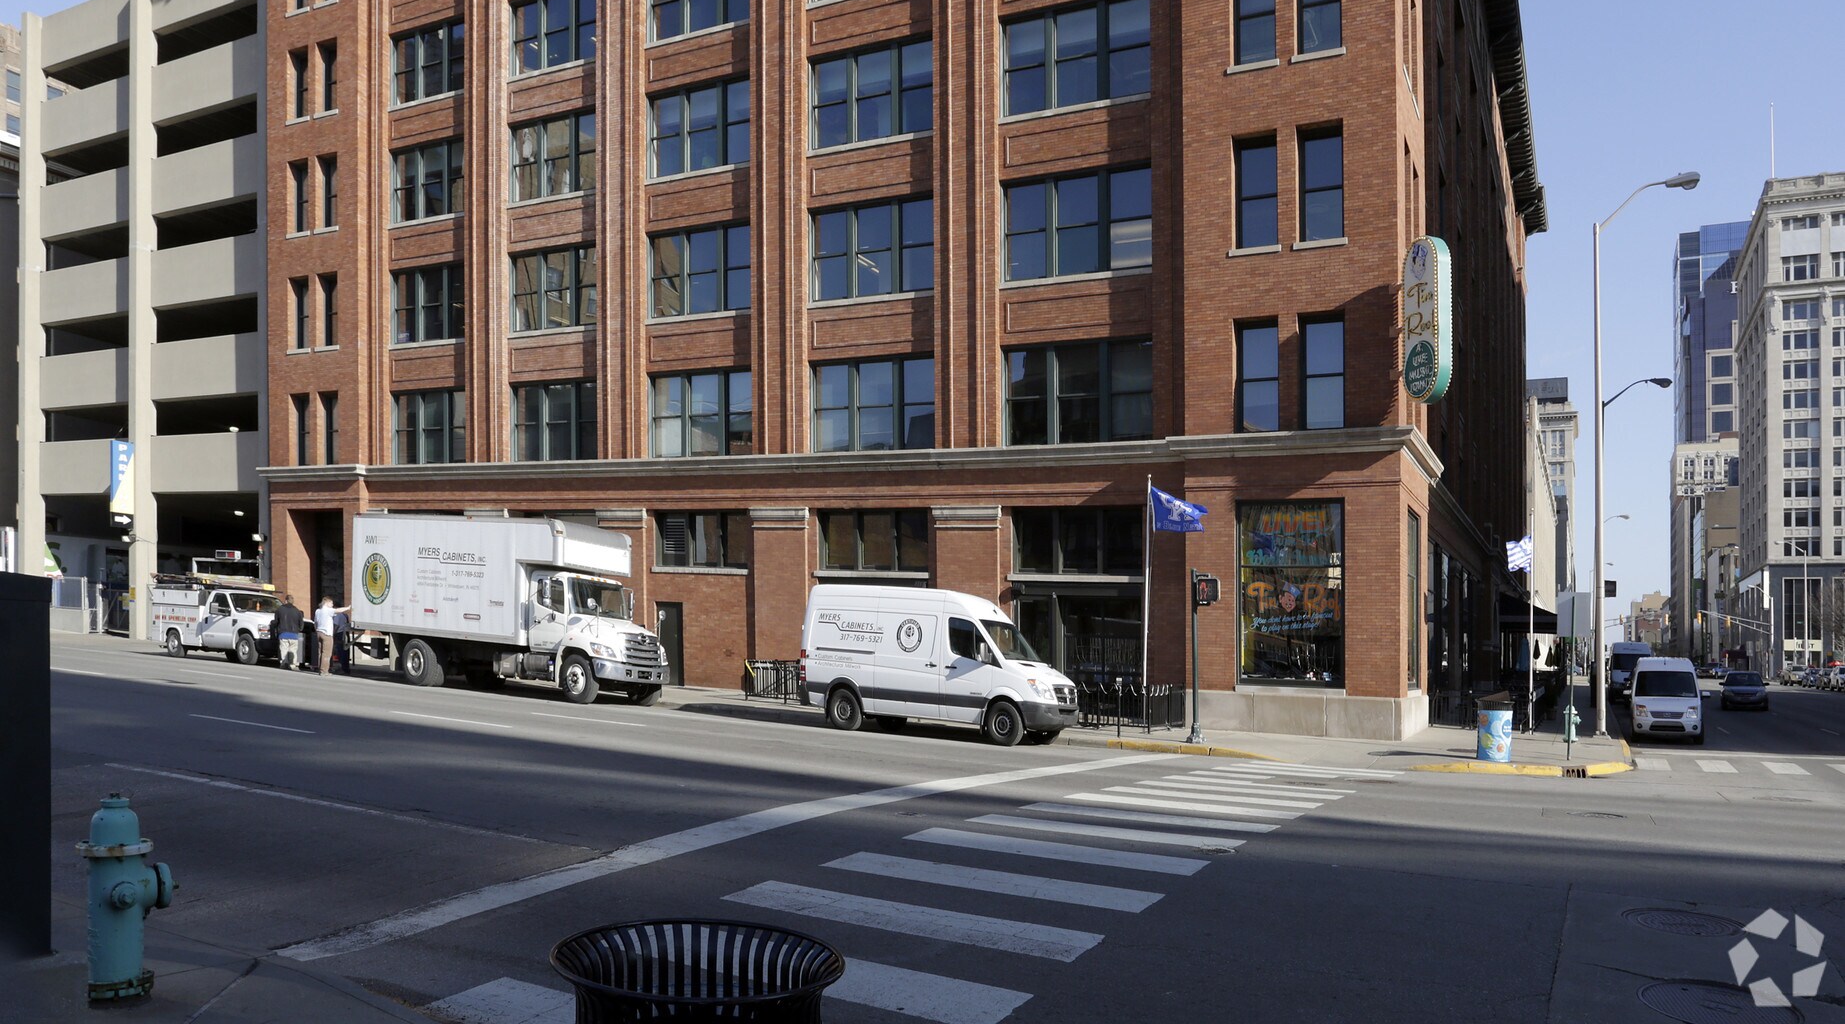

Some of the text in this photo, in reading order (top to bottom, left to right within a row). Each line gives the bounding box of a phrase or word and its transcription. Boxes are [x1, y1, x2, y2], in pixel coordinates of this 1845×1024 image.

[1407, 282, 1433, 309] Tin
[418, 547, 441, 557] MYERS
[442, 552, 477, 563] CABINETS,
[1248, 582, 1341, 621] Tin Roof
[819, 613, 841, 621] MYERS
[841, 621, 876, 632] CABINETS,
[840, 633, 883, 643] 317-769-5321
